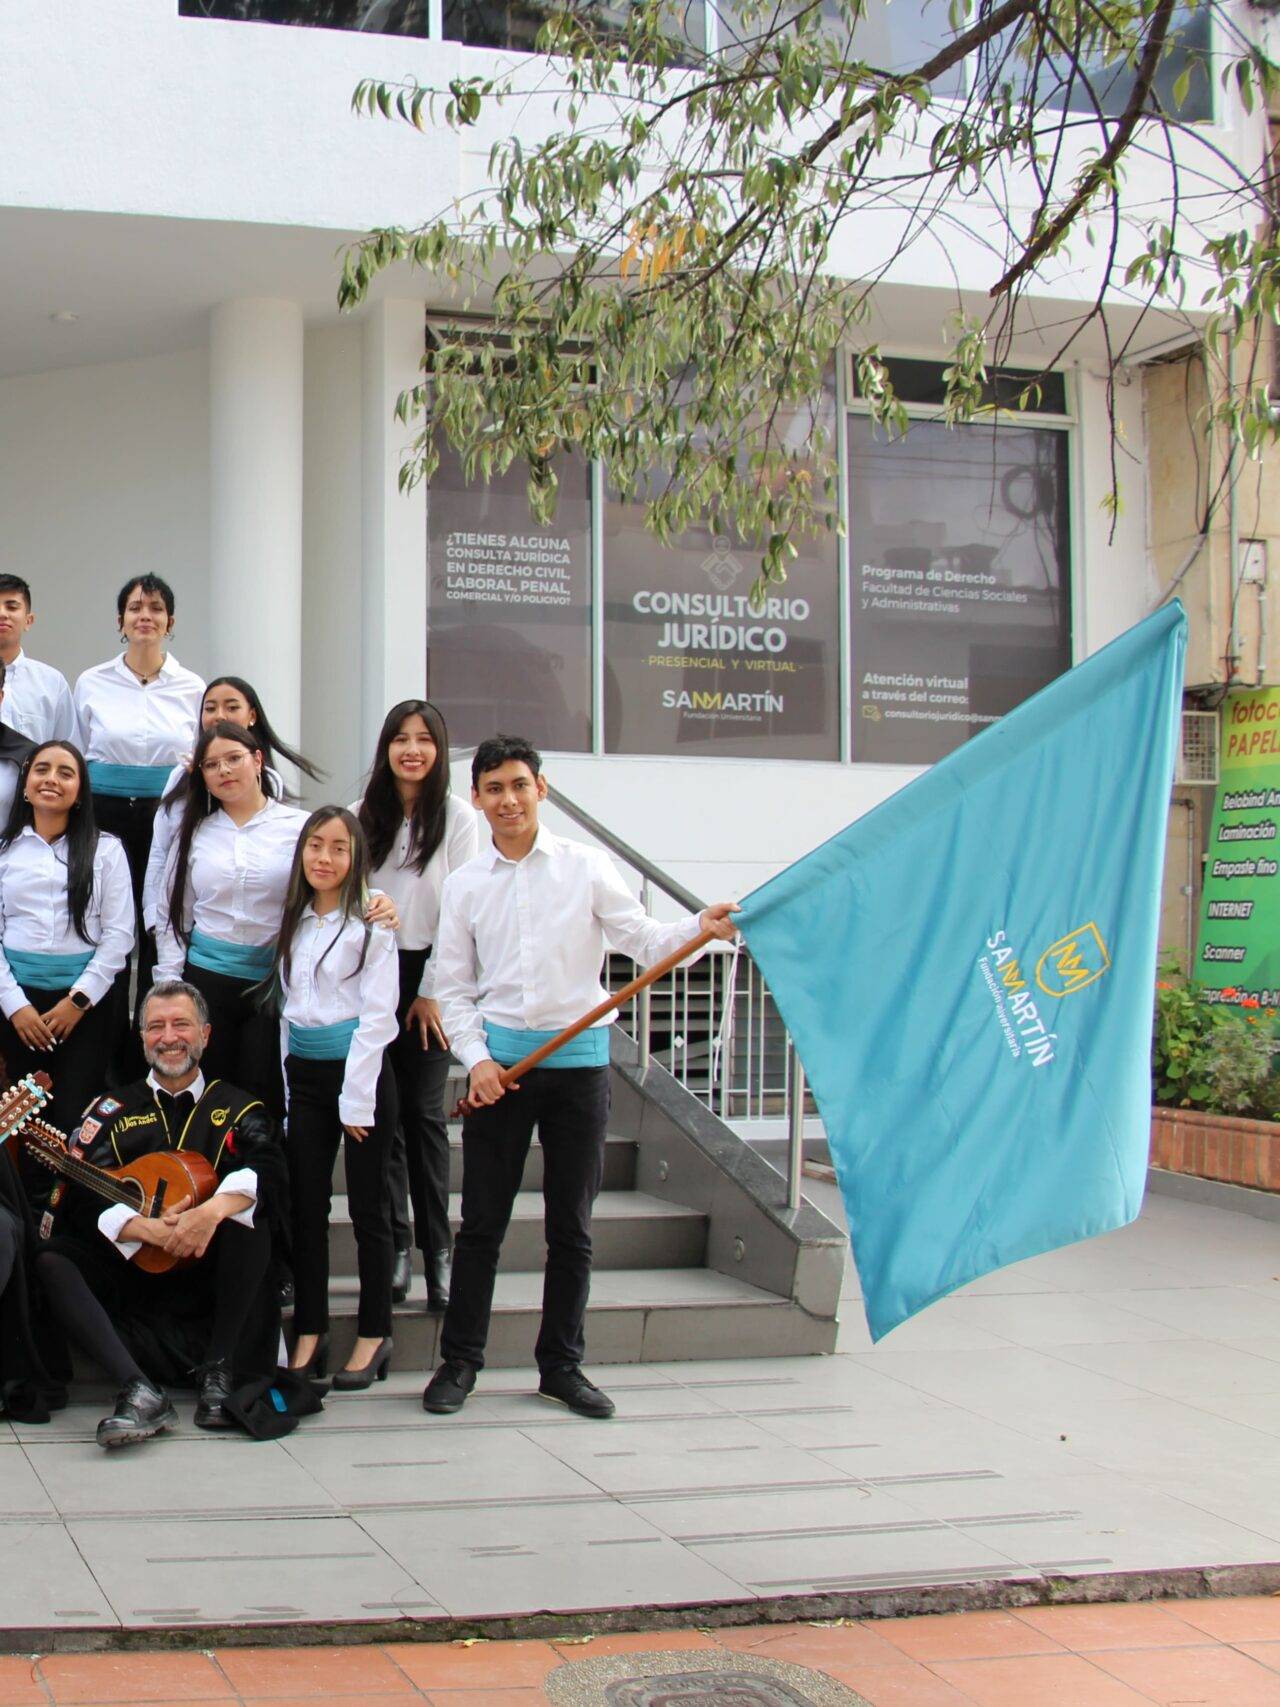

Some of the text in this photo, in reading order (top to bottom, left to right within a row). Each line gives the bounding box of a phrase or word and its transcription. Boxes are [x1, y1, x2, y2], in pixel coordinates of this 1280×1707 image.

[446, 532, 570, 551] ¿TIENES ALGUNA
[446, 547, 570, 564] CONSULTA JURÍDICA
[446, 562, 571, 580] EN DERECHO CIVIL,
[862, 565, 997, 584] Programa de Derecho
[446, 577, 571, 595] LABORAL, PENAL,
[862, 582, 1028, 603] Facultad de Ciencias Sociales
[446, 591, 502, 602] COMERCIAL
[504, 594, 521, 603] Y/O
[862, 597, 960, 613] y Administrativas
[633, 591, 810, 621] CONSULTORIO
[657, 617, 788, 653] JURÍDICO
[649, 655, 797, 672] PRESENCIAL Y VIRTUAL
[863, 672, 969, 689] Atención virtual
[862, 690, 969, 704] a través del correo:
[1231, 699, 1280, 725] fotoc
[1256, 859, 1277, 874] fino
[1208, 902, 1253, 918] INTERNET
[1203, 944, 1245, 961] Scanner
